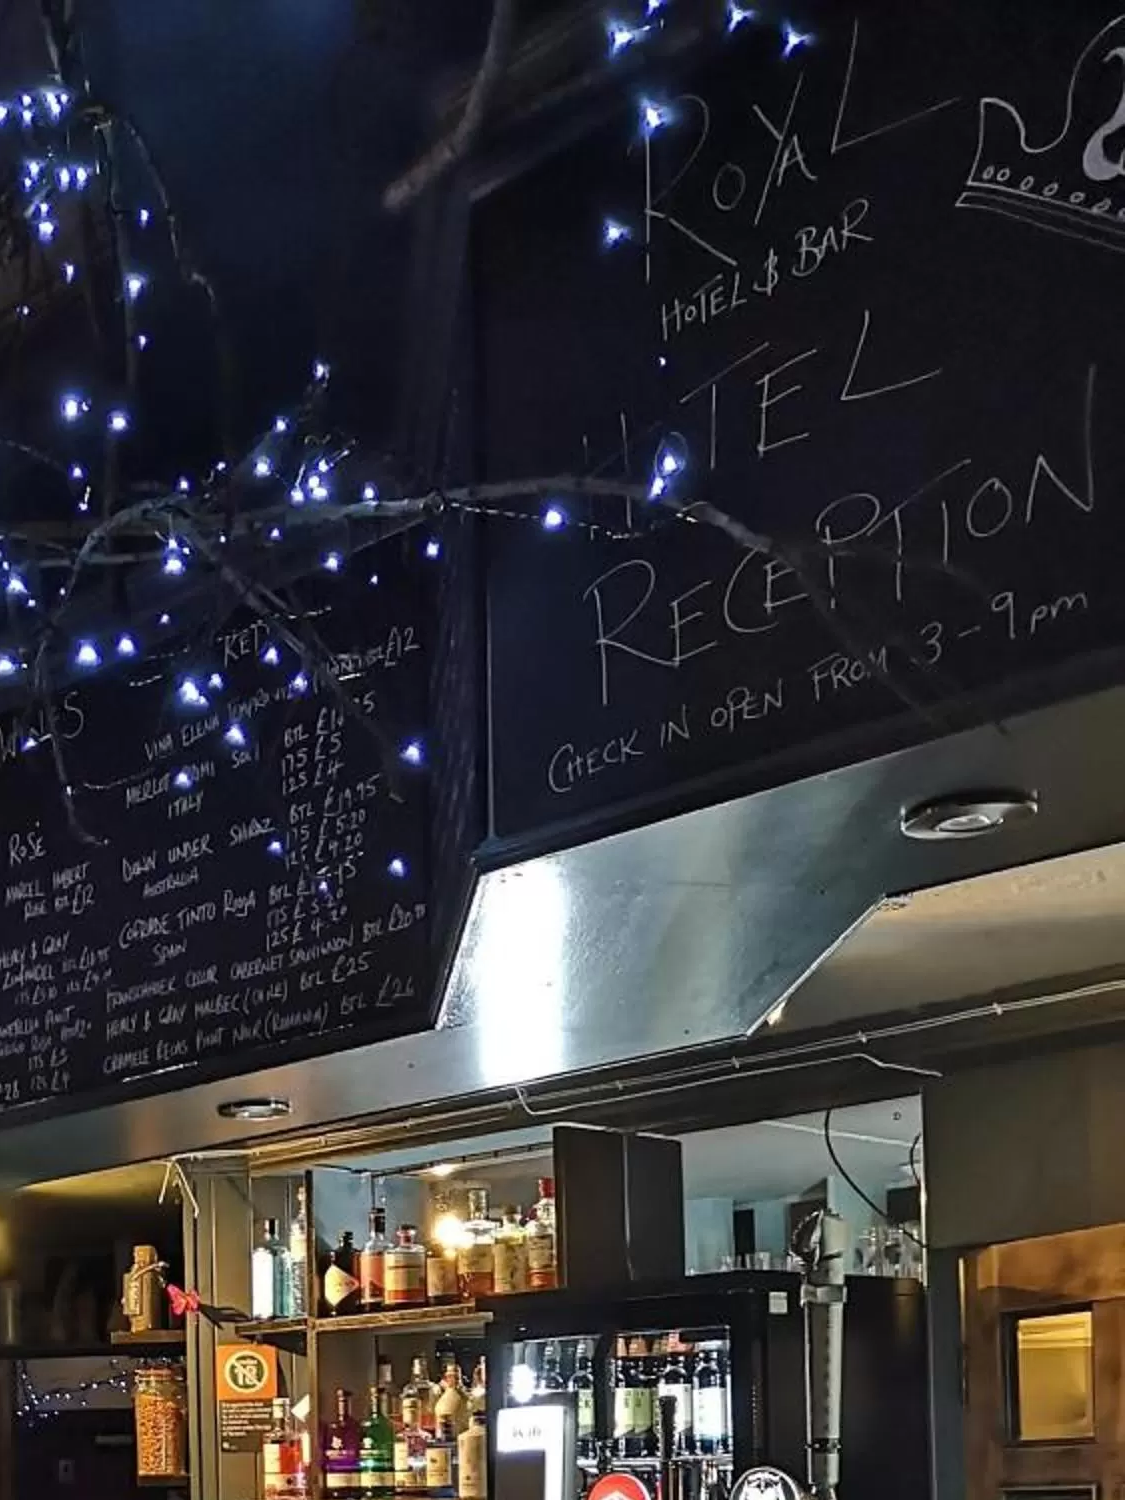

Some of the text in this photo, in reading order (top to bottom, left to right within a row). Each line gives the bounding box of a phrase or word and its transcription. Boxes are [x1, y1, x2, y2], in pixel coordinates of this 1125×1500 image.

[640, 15, 963, 286] ROYAL
[660, 271, 749, 341] HOTEL
[792, 198, 875, 280] BAR
[582, 363, 1098, 707] RECEPTION
[284, 723, 310, 748] BTL
[546, 728, 647, 794] CHECK
[658, 703, 692, 748] IN
[710, 677, 788, 735] OPEN
[808, 645, 890, 707] FROM
[282, 747, 309, 777] 175
[282, 772, 309, 796] 125
[289, 802, 315, 824] BTL
[122, 849, 158, 884] DOWN
[167, 832, 214, 863] UNDER
[176, 900, 217, 933] TINTO
[266, 927, 289, 952] 125
[331, 950, 380, 984] £25
